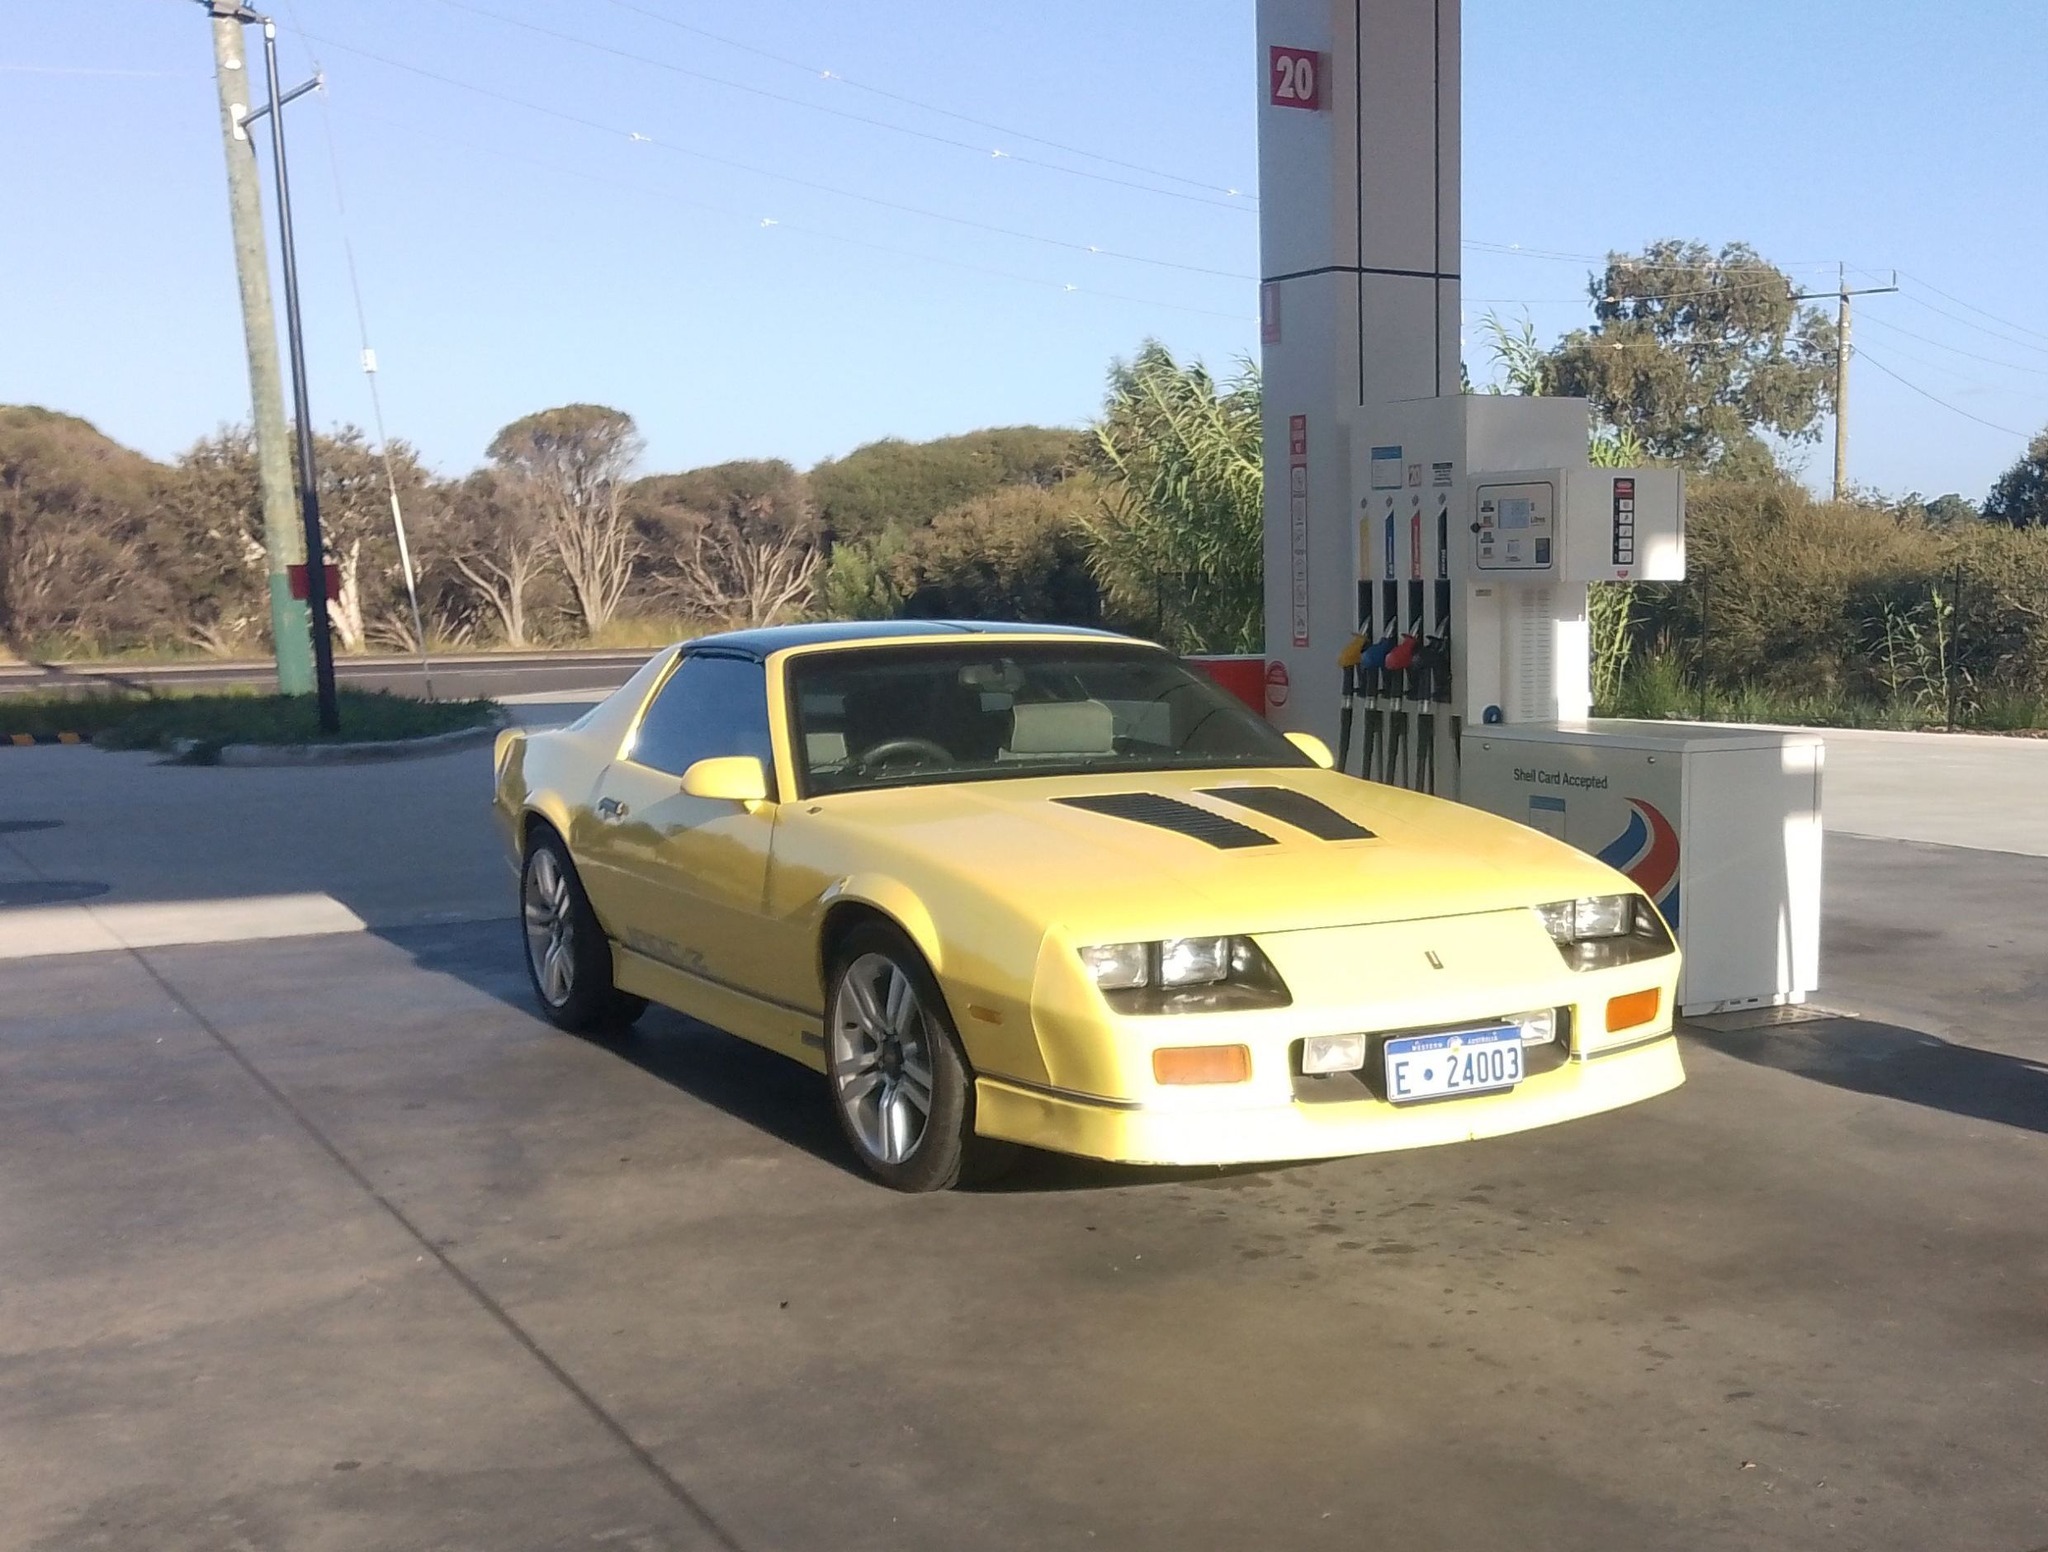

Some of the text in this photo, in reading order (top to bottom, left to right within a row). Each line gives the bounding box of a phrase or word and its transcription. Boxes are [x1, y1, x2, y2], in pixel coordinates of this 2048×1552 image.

[1276, 55, 1313, 101] 20
[1513, 767, 1608, 791] Shell Card Accepted
[1395, 1047, 1519, 1095] E 24003
